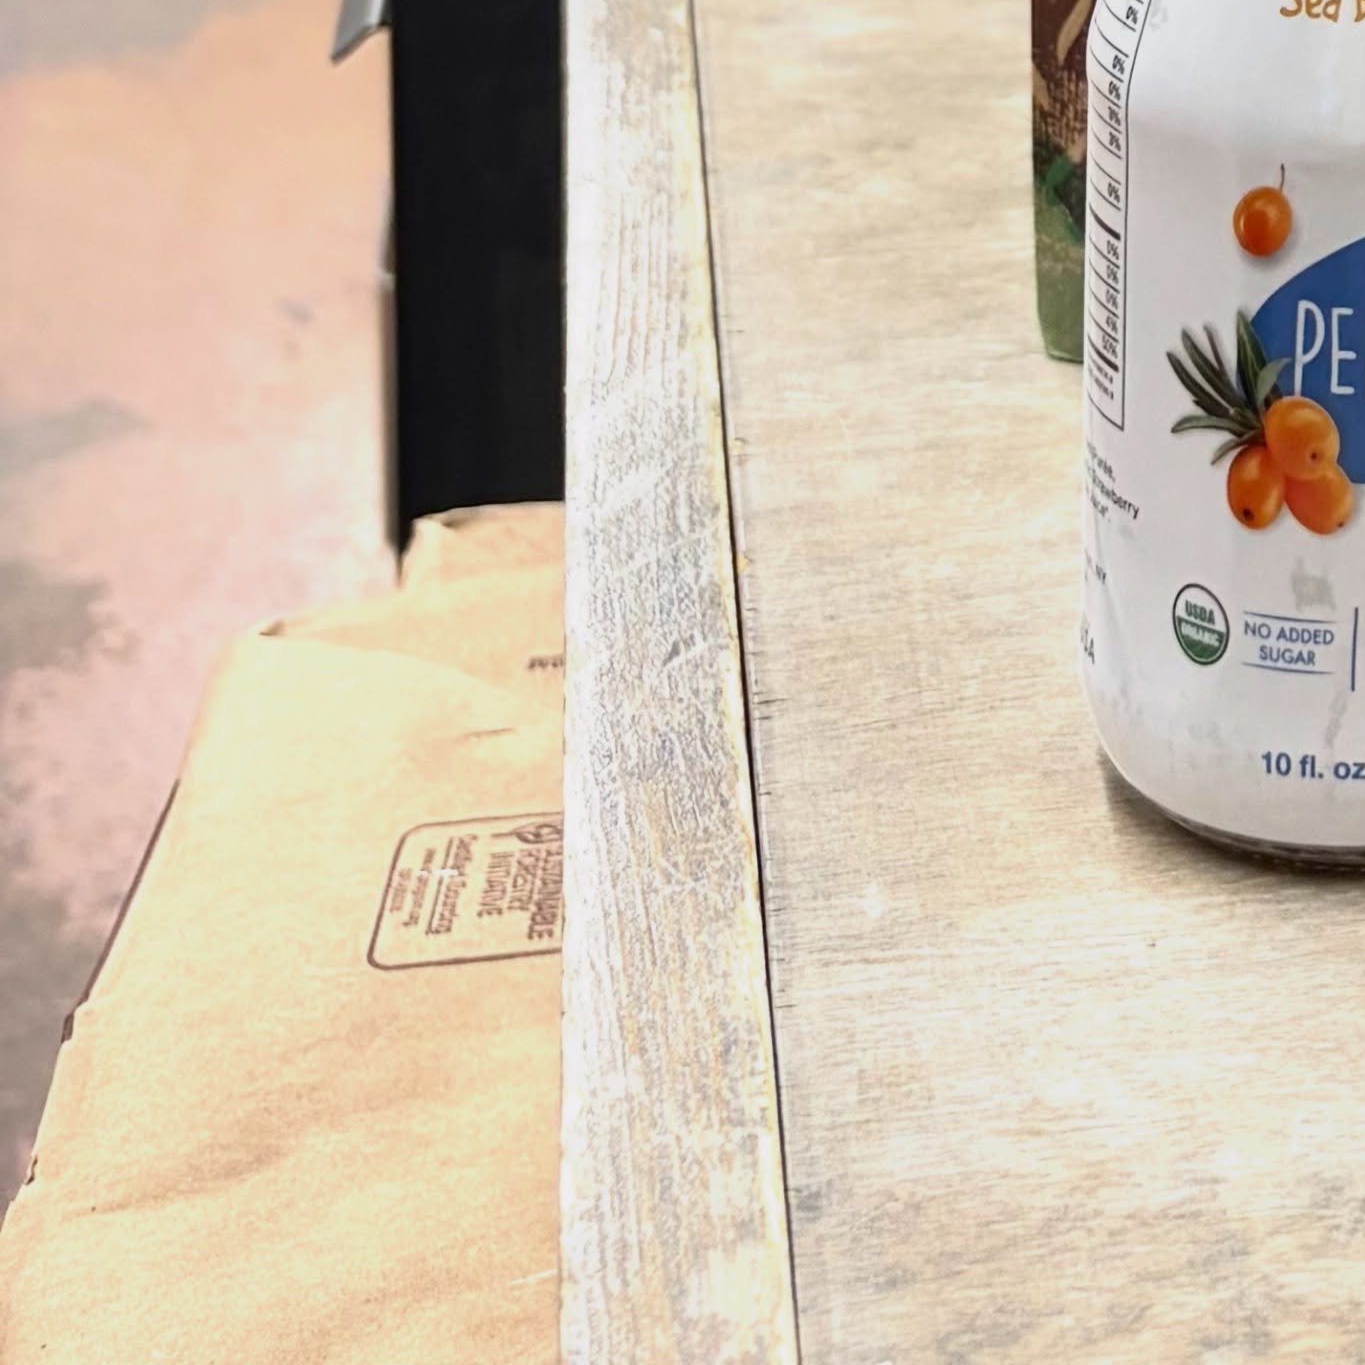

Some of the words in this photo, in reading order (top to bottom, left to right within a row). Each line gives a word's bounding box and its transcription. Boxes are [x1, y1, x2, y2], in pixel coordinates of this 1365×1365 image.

[1126, 5, 1138, 25] 0%
[1185, 599, 1216, 626] USDA
[1244, 620, 1272, 639] NO
[1276, 626, 1335, 645] ADDED
[1259, 645, 1317, 666] SUGAR
[1261, 750, 1292, 776] 10
[1299, 754, 1324, 779] fl.
